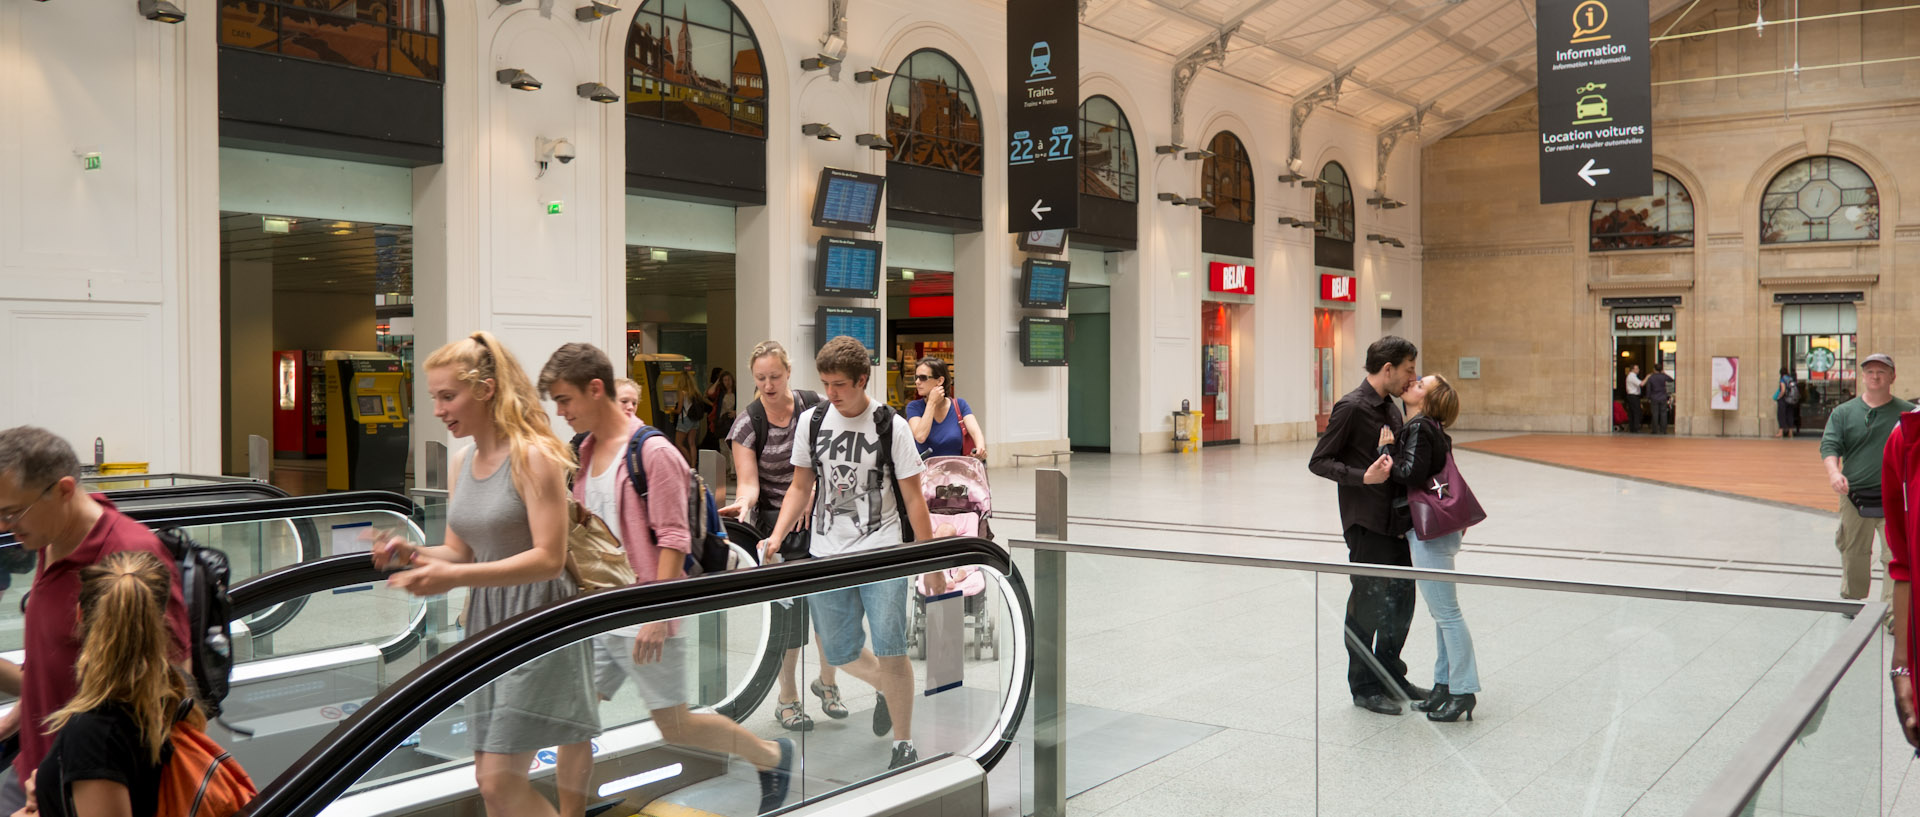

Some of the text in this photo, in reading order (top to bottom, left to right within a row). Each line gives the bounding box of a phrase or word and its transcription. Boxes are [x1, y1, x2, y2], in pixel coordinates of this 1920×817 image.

[1556, 44, 1627, 61] Information
[1552, 55, 1631, 70] Information Información
[1027, 86, 1055, 98] Trains
[1542, 125, 1645, 144] Location voitures
[1010, 134, 1073, 161] 22 à 27
[1544, 137, 1642, 153] Car rental Alquiler automóviles
[1223, 265, 1246, 291] RELAY
[1331, 276, 1350, 299] RELAY
[1616, 314, 1671, 324] STARBUCKS
[1626, 320, 1662, 329] COFFEE
